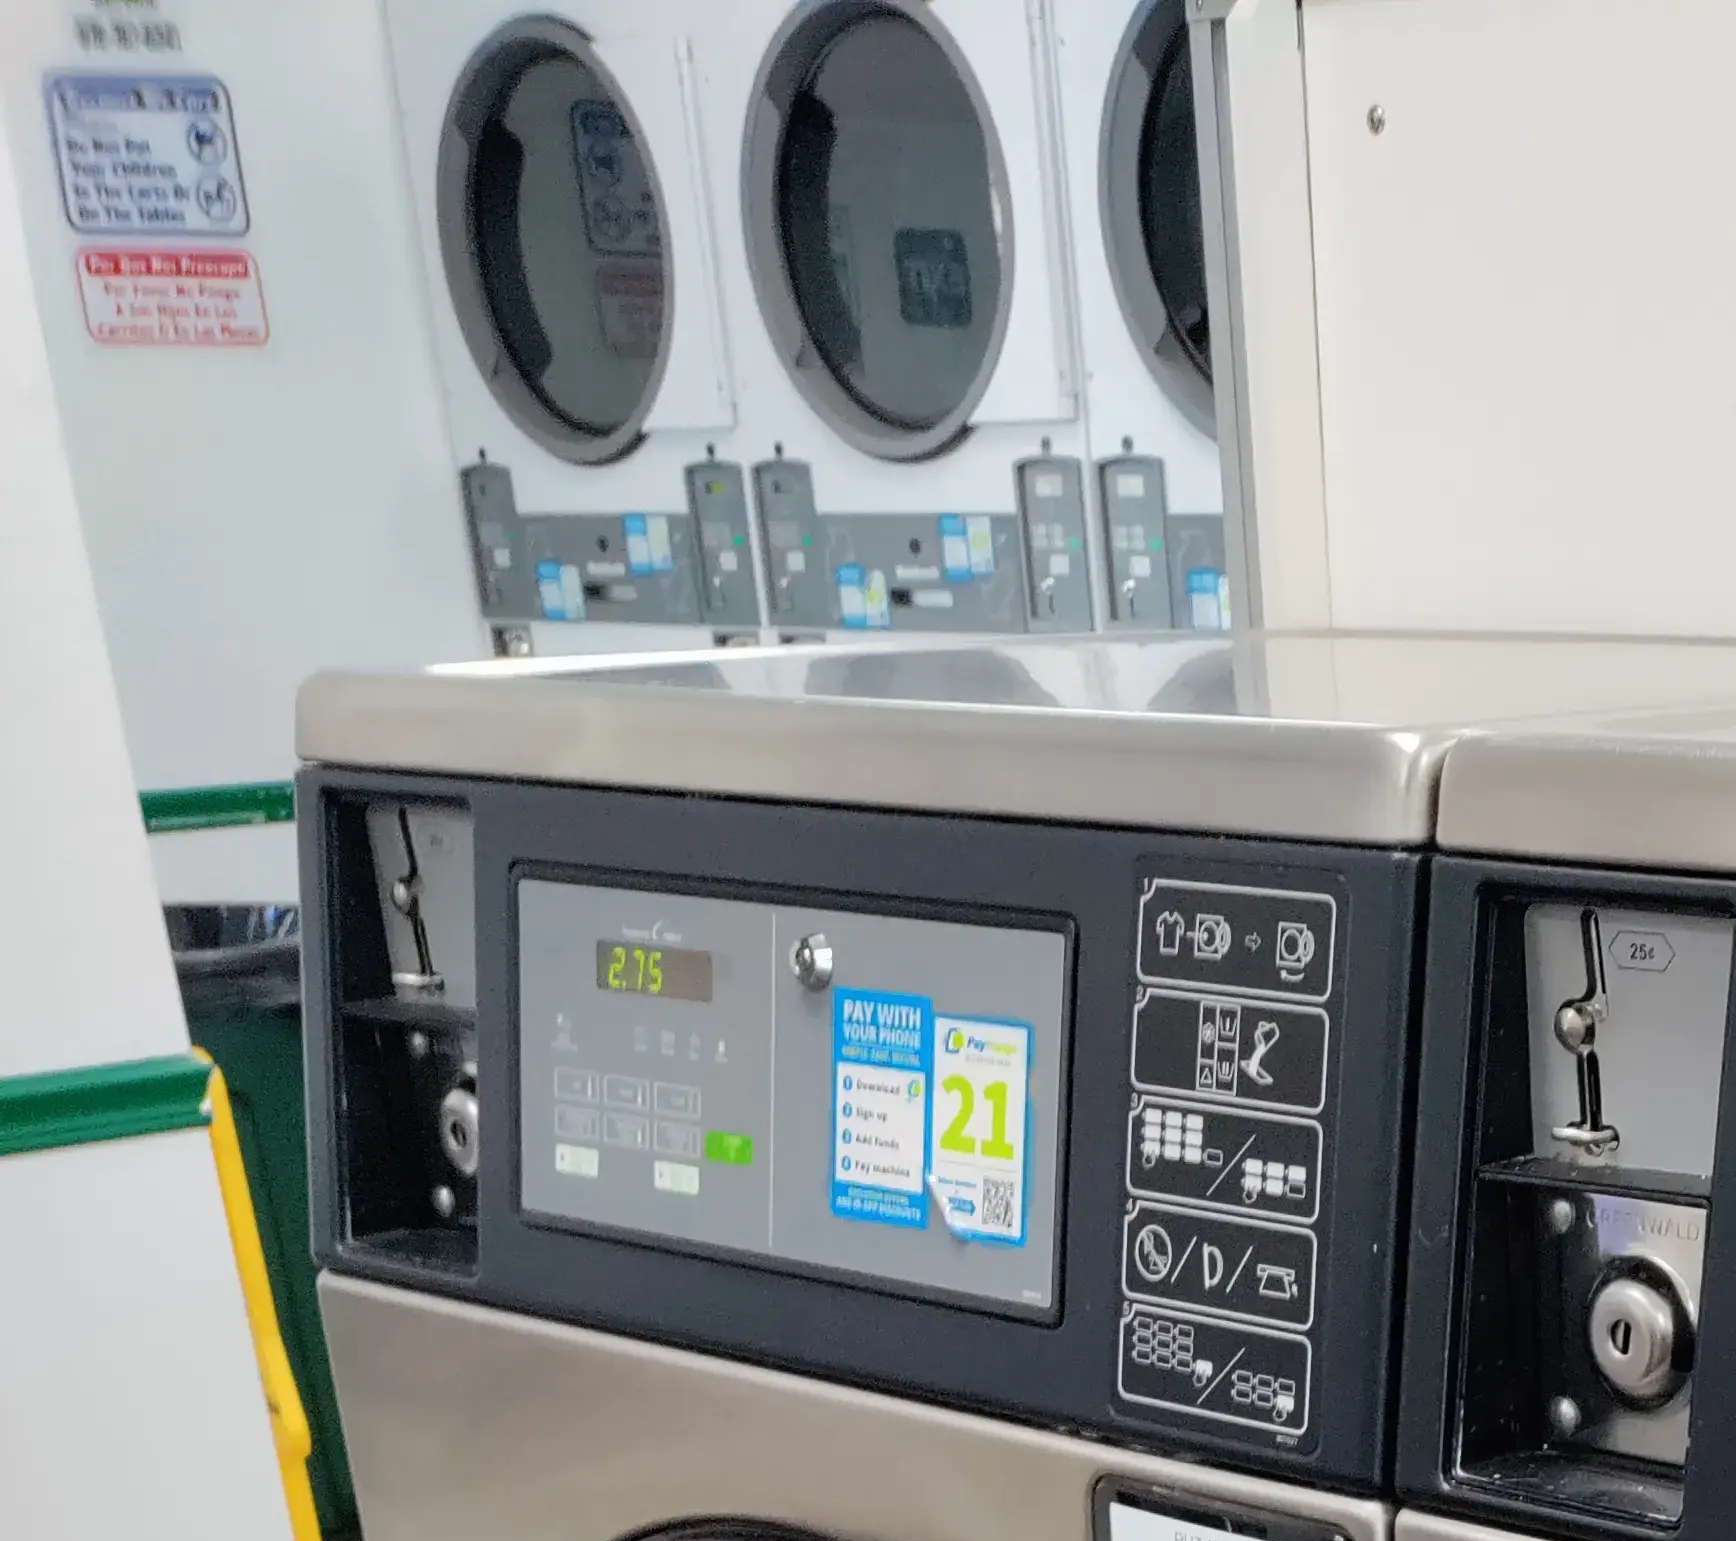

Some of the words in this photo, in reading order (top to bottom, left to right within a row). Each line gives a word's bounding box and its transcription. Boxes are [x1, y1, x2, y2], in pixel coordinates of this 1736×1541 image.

[608, 946, 663, 994] 2.75
[843, 999, 875, 1024] PAY
[877, 1002, 921, 1030] WITH
[843, 1021, 877, 1043] YOUR
[879, 1027, 921, 1050] PHONE
[939, 1073, 1015, 1160] 21
